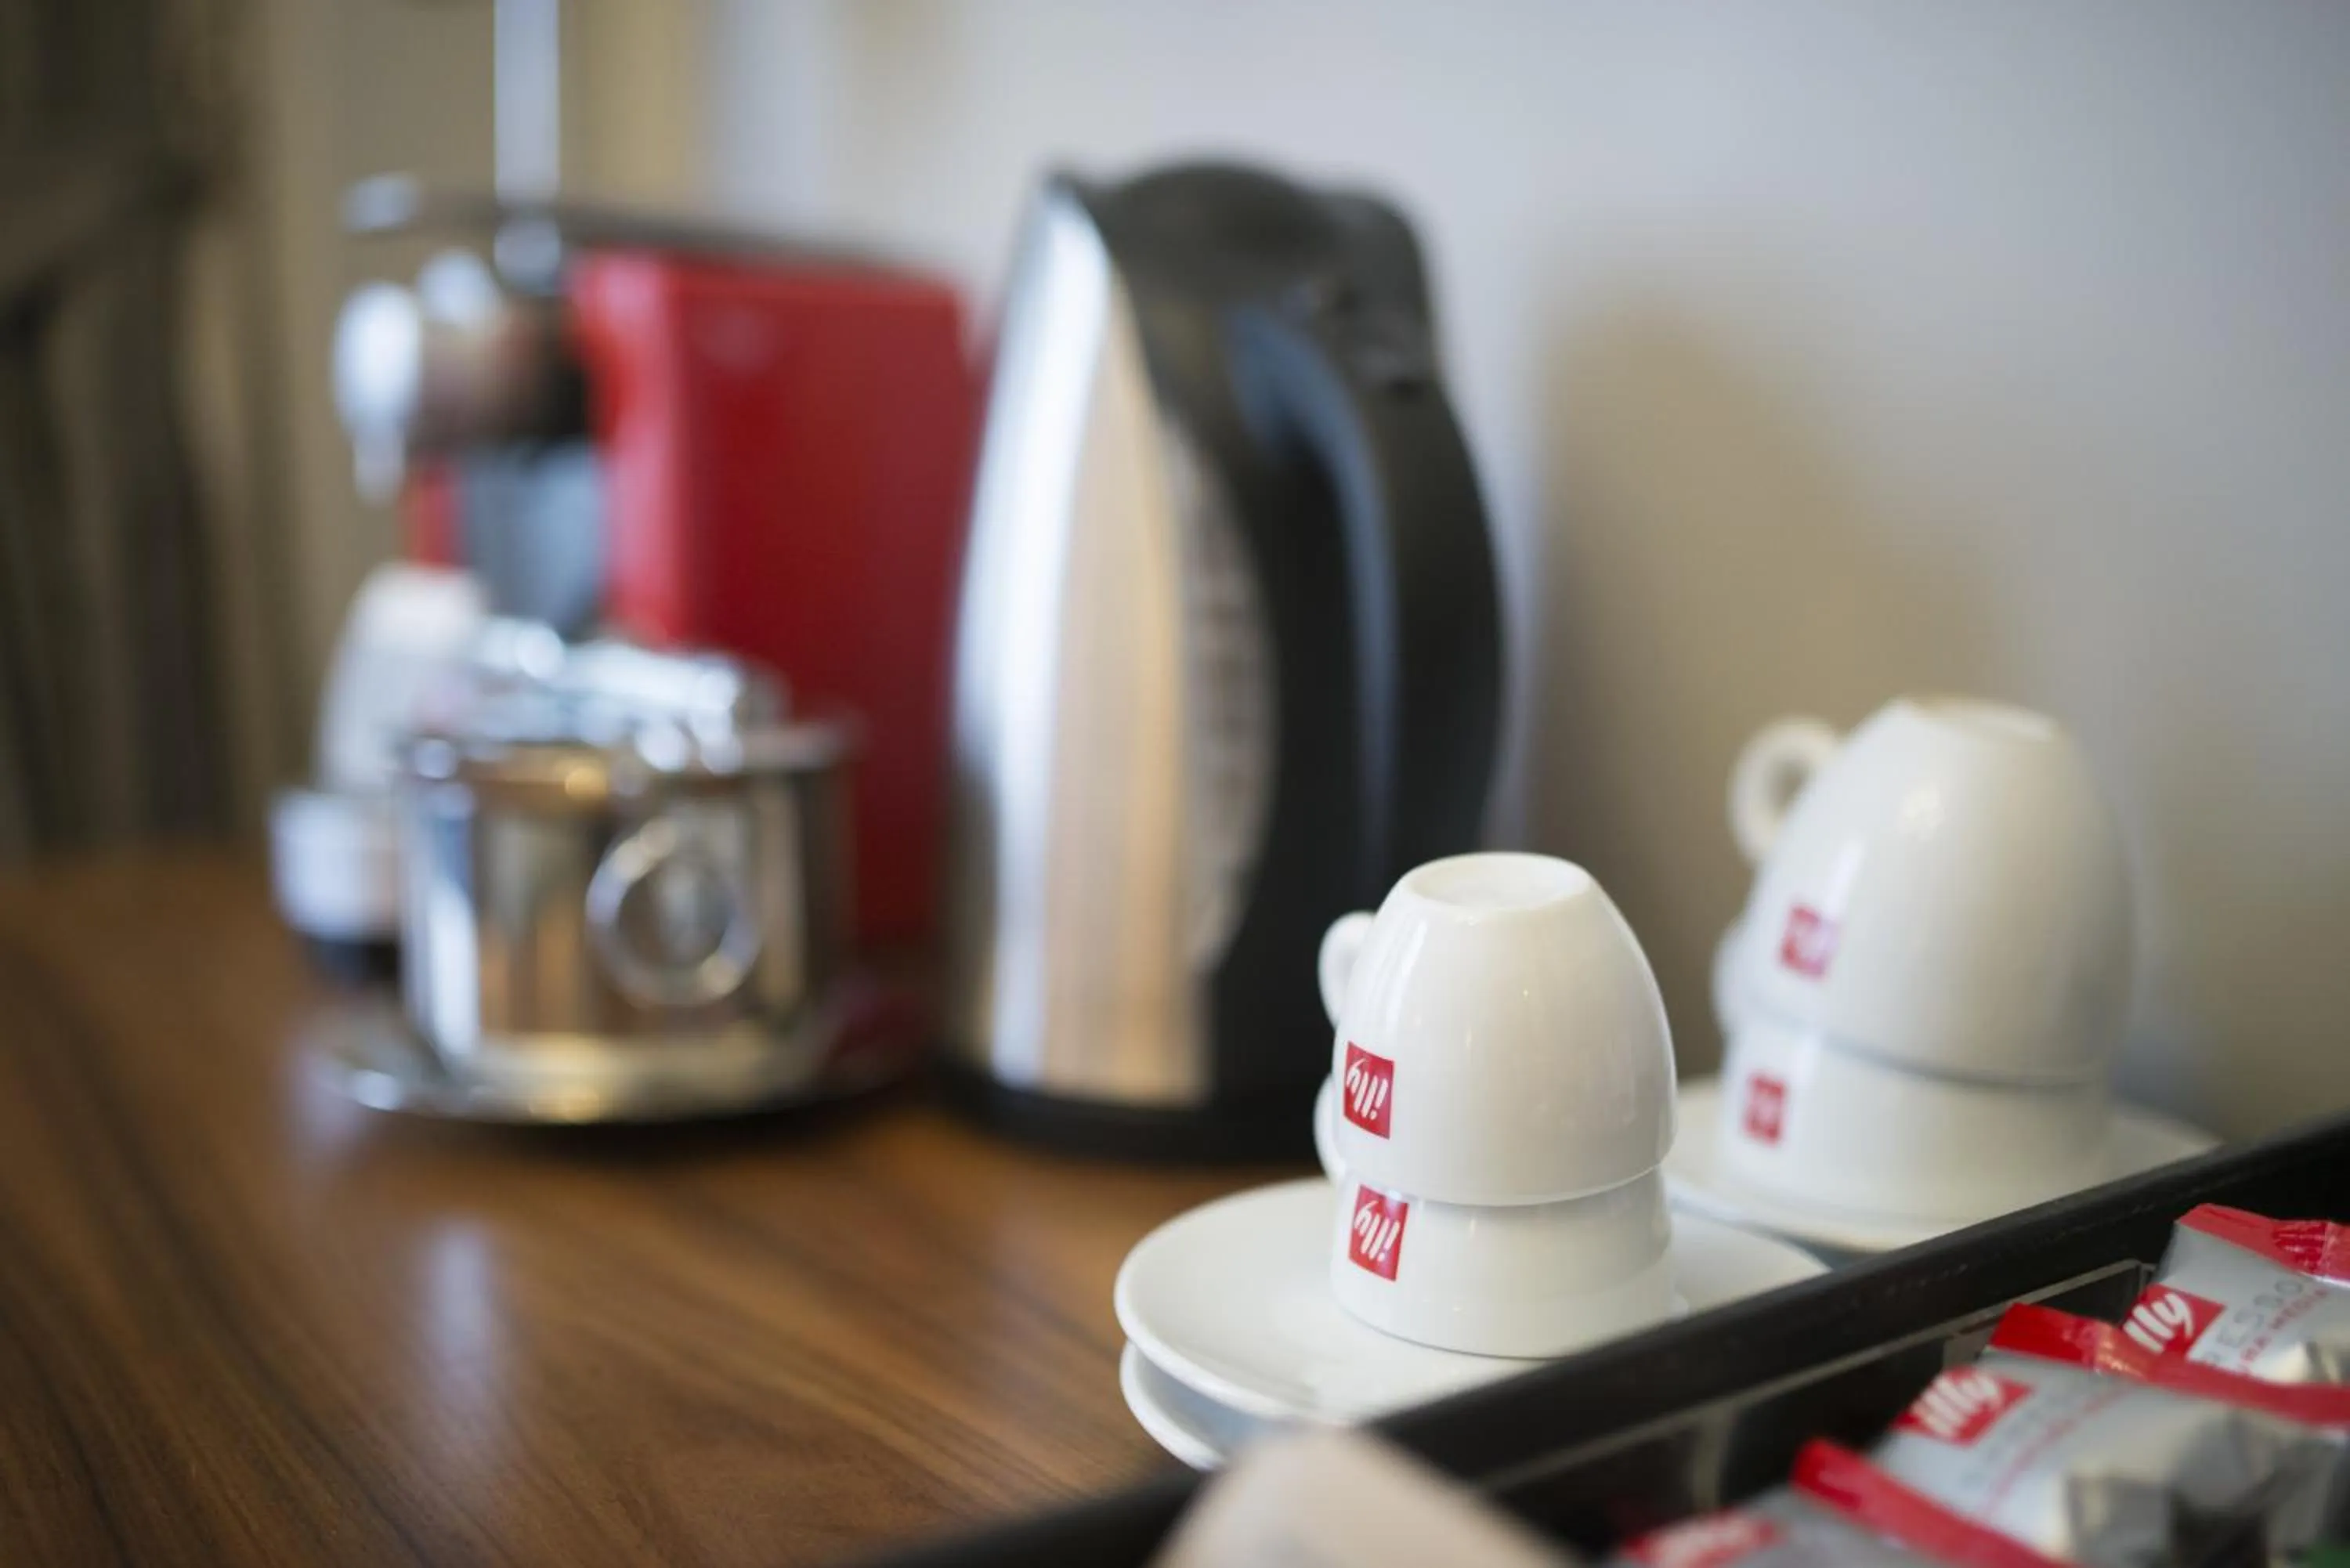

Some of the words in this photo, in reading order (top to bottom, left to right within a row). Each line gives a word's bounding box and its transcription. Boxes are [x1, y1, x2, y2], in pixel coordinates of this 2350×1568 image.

[1346, 1058, 1388, 1121] illy
[1354, 1200, 1401, 1262] illy
[2122, 1293, 2193, 1354] lly
